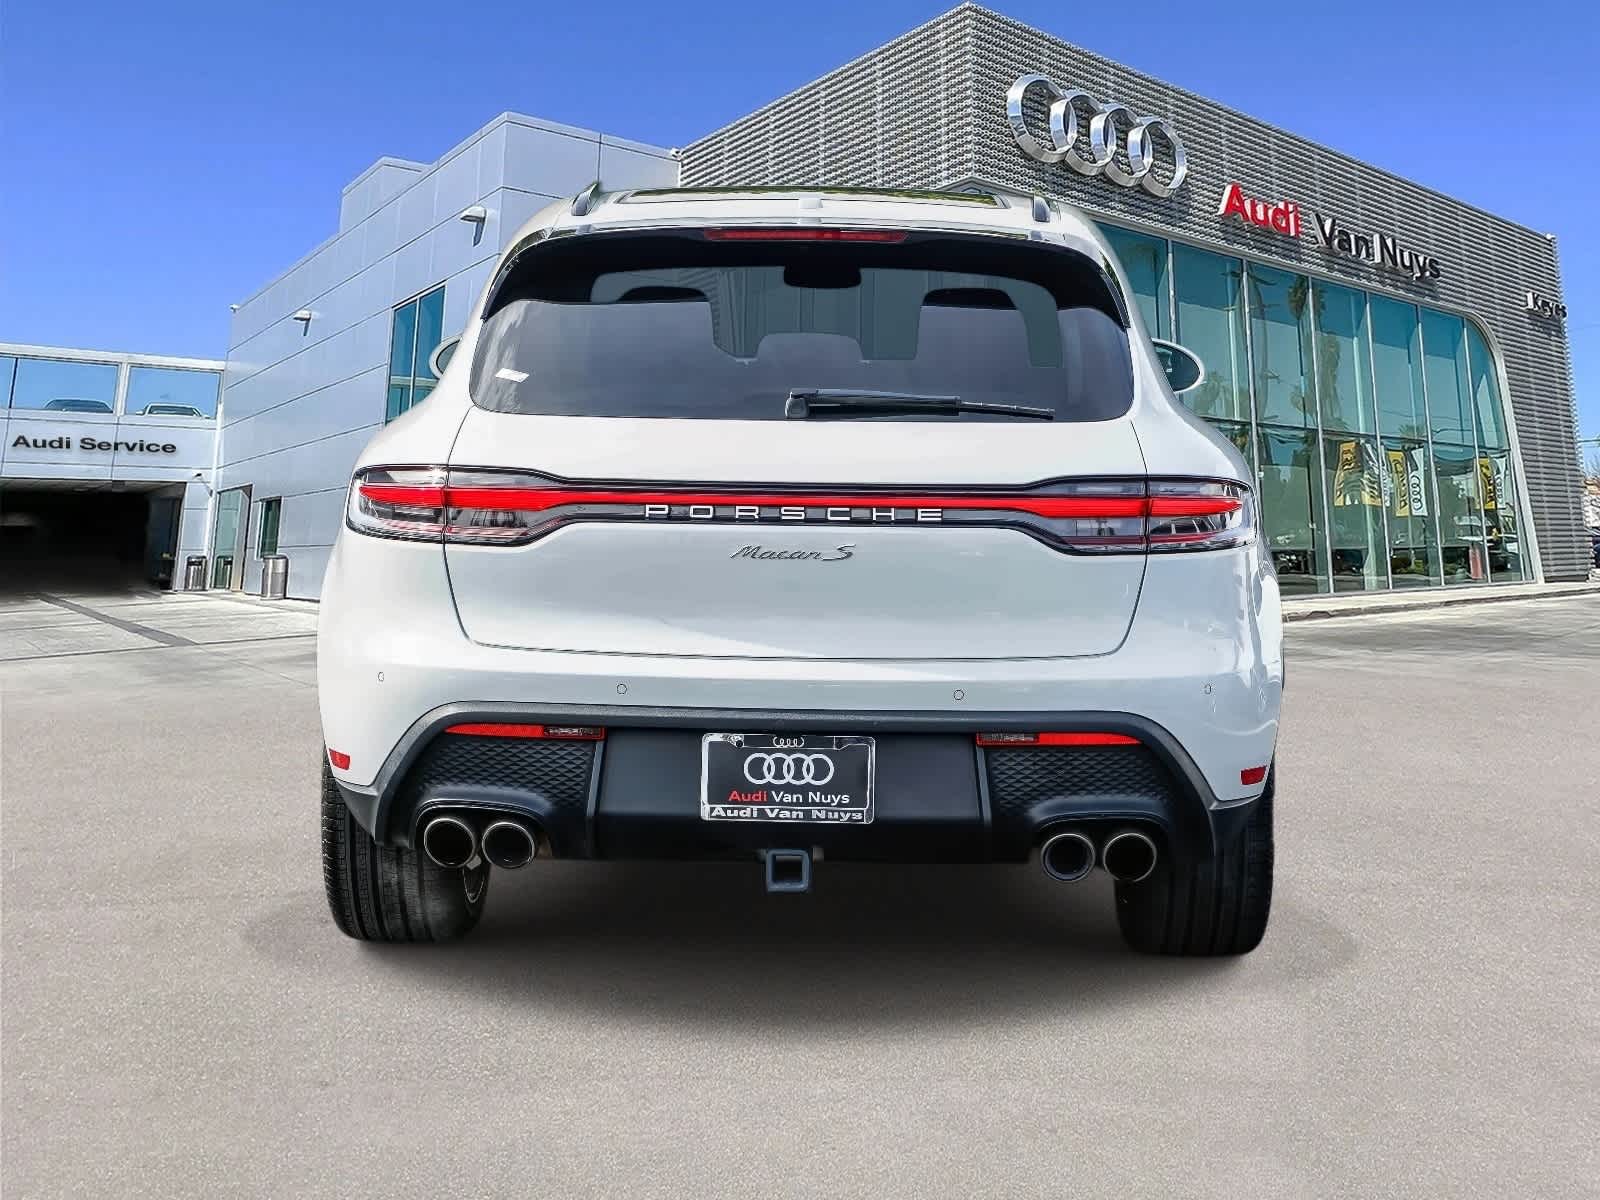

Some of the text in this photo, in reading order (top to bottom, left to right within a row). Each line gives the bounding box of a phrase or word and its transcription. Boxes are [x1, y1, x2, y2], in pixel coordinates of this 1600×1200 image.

[1219, 183, 1441, 280] Audi Van Nuys
[1526, 292, 1568, 319] Keyes
[12, 435, 177, 453] Audi Service
[645, 504, 943, 521] PORSCHE
[729, 544, 856, 561] Macan S
[728, 790, 850, 806] Audi Van Nuys
[711, 807, 864, 822] Audi Van Nuys
